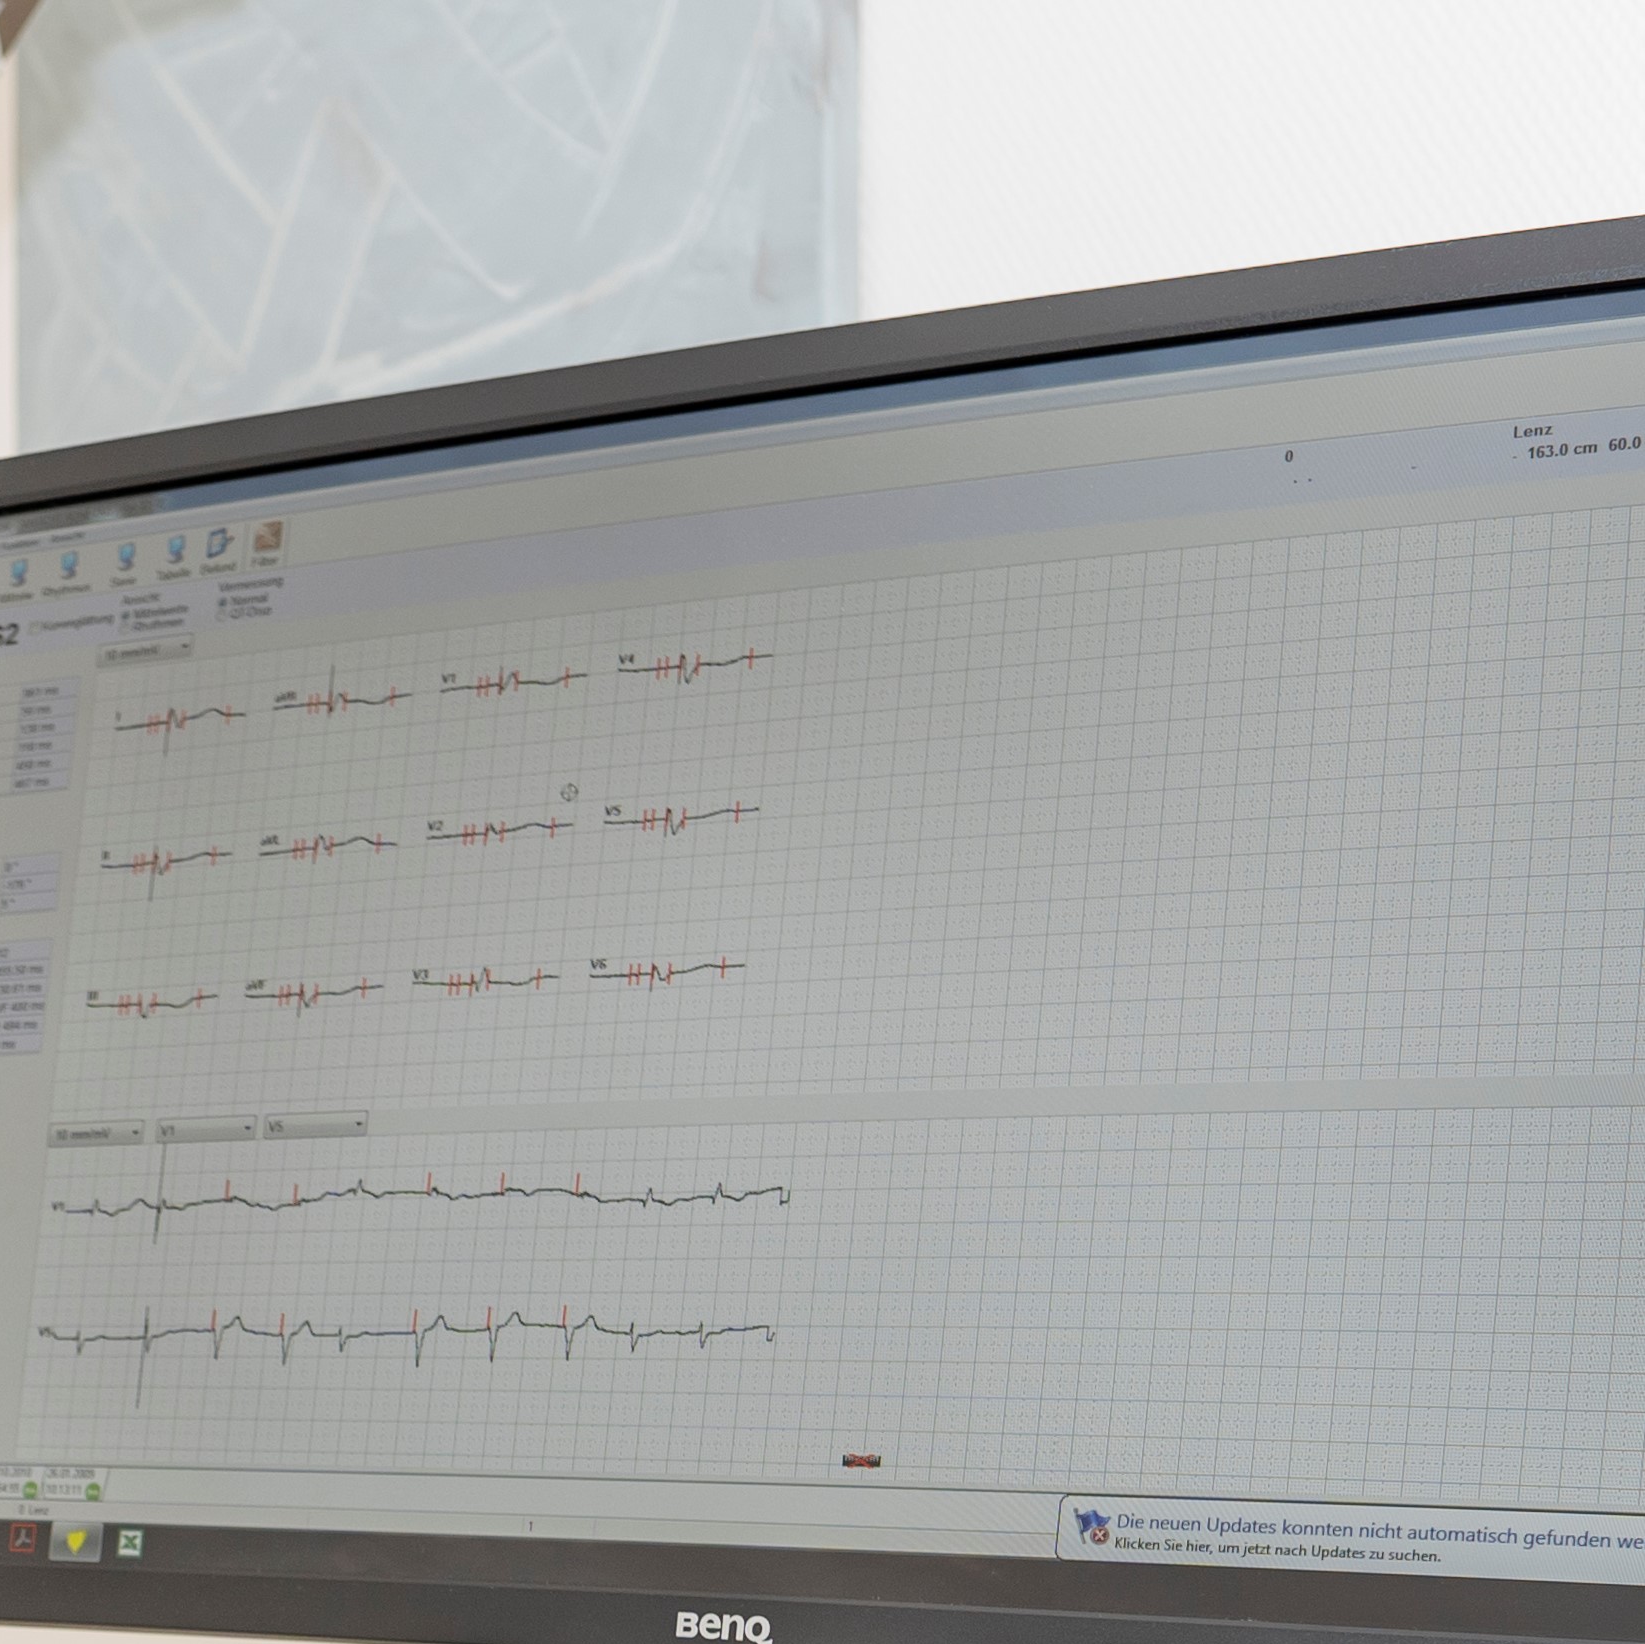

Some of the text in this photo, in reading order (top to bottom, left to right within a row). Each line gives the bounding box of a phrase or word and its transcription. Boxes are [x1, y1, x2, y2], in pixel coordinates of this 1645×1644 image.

[1513, 425, 1553, 438] Lenz
[1528, 436, 1642, 459] 163.0 cm 60.0
[604, 805, 622, 817] V5
[427, 819, 445, 831] V2
[1116, 1513, 1645, 1550] Die neuen Updates konnten nicht automatisch gefunden we
[1114, 1537, 1442, 1563] Klicken Sie hier, um jetzt nach Updates zu suchen.
